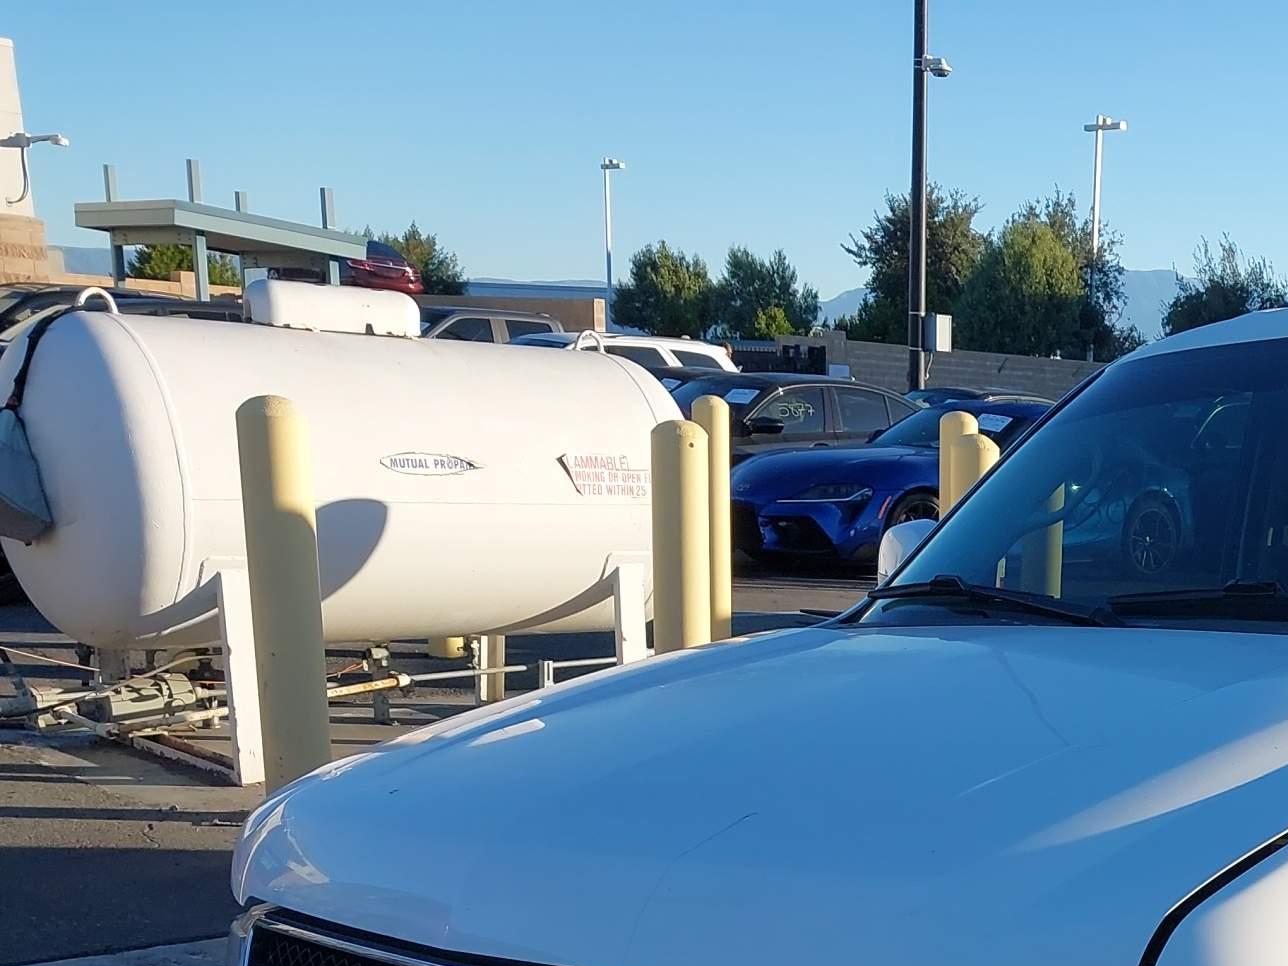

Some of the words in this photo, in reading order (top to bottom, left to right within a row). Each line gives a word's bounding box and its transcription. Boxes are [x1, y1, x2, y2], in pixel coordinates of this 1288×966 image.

[389, 457, 431, 469] MUTUAL
[605, 484, 634, 497] WITHIN
[635, 484, 647, 497] 25
